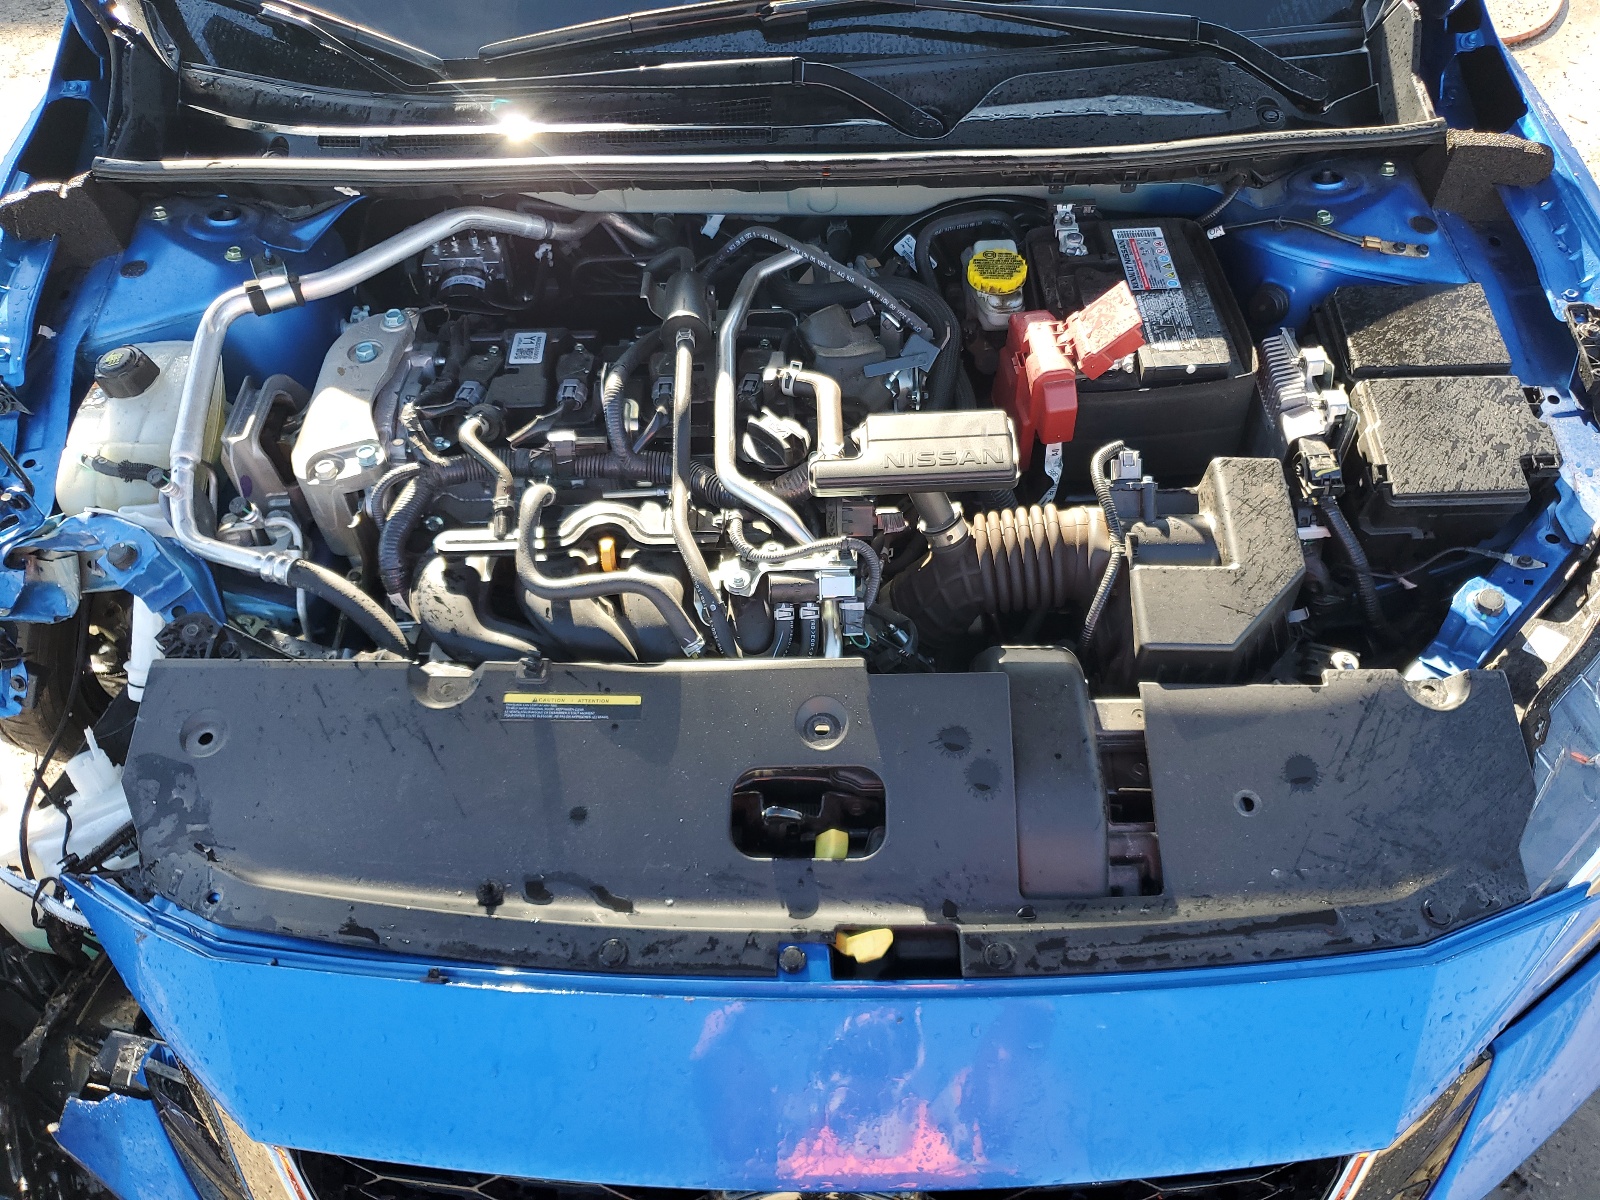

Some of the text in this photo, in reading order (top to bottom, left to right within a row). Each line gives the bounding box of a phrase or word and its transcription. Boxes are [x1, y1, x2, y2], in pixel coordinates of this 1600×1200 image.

[1119, 241, 1132, 265] NISSAN
[522, 336, 537, 345] Y1
[883, 447, 1004, 469] NISSAN
